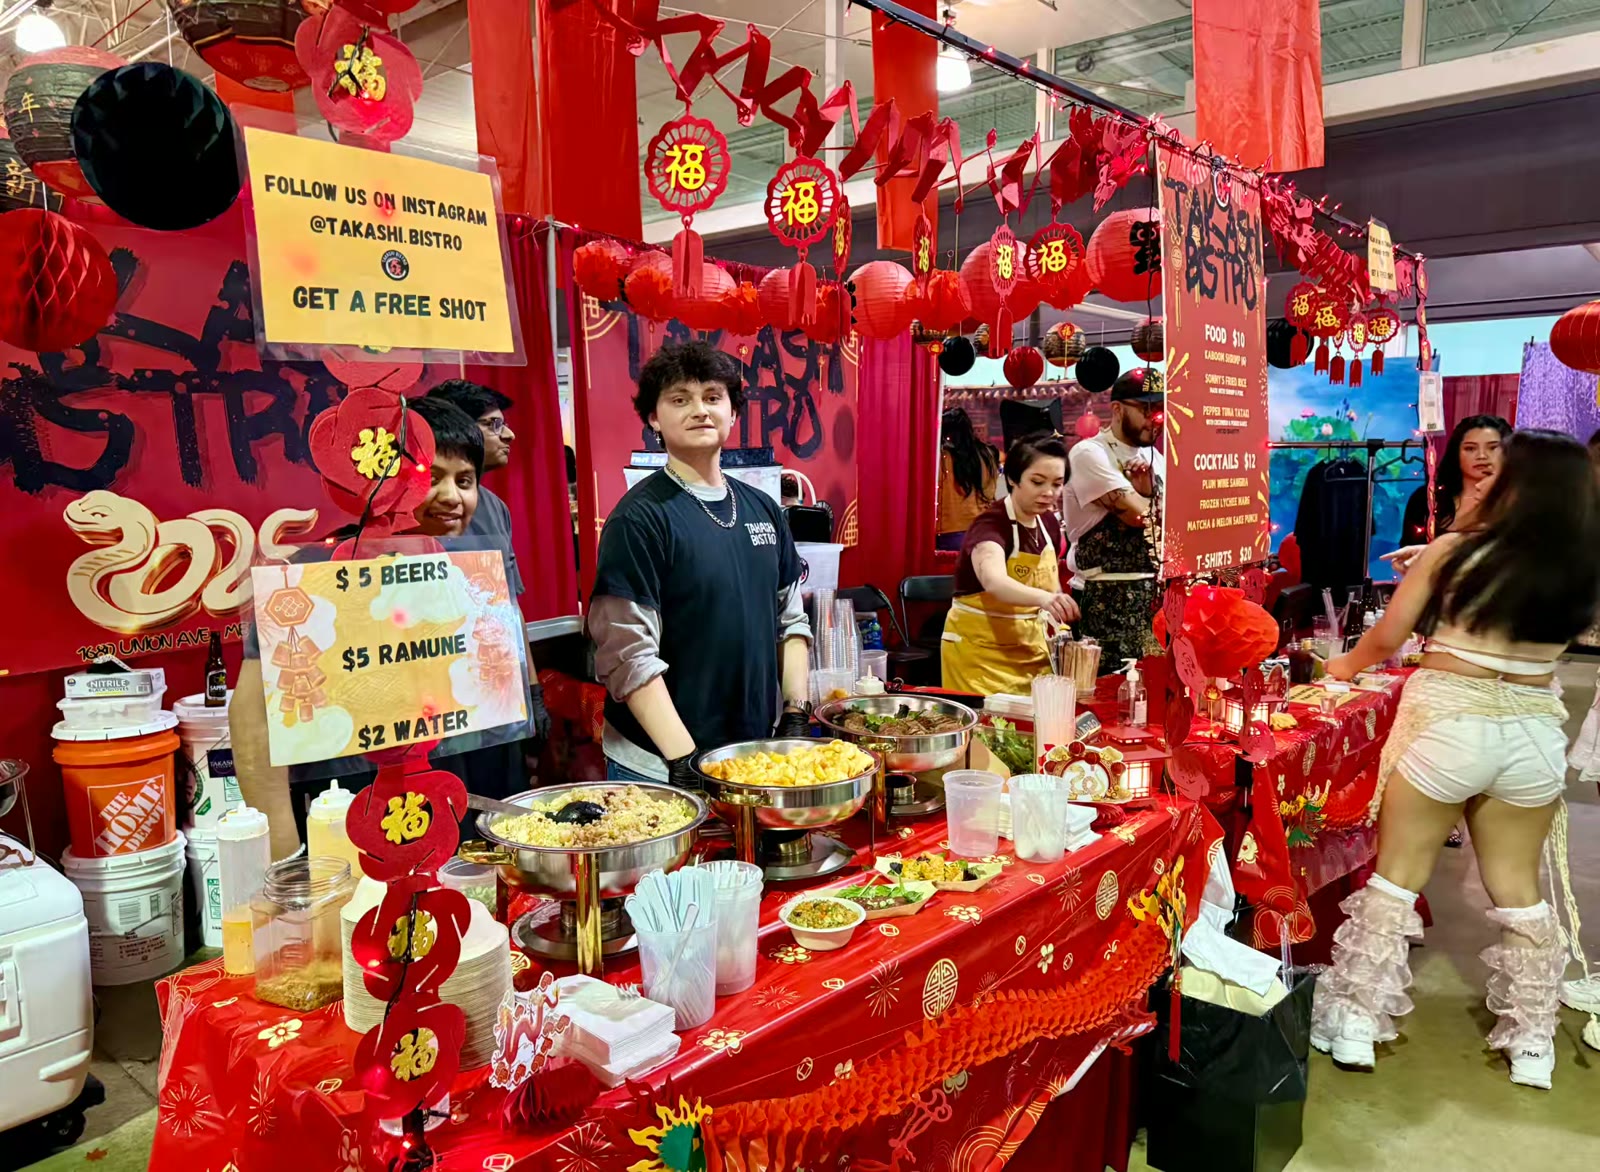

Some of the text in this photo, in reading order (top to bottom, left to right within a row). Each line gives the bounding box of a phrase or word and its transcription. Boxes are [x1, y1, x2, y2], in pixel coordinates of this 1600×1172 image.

[19, 92, 41, 123] 年
[665, 143, 706, 190] 福
[264, 174, 488, 226] FOLLOW US ON INSTAGRAM
[781, 180, 819, 226] 福
[310, 215, 463, 251] @TAKASHI.BISTRO
[996, 244, 1013, 279] 福
[1039, 239, 1068, 274] 福
[293, 285, 487, 321] GET A FREE SHOT
[1292, 294, 1310, 317] 福
[1314, 306, 1337, 329] 福
[1205, 323, 1245, 348] FOOD $10
[1371, 316, 1391, 336] 福
[1203, 405, 1221, 416] PEPPER
[1194, 451, 1256, 471] COCKTAILS $12
[1200, 498, 1220, 510] FROZEN
[1220, 496, 1238, 508] LYCHEE
[1187, 518, 1211, 531] MATCHA
[381, 560, 449, 586] BEERS
[1196, 546, 1252, 570] T-SHIRTS $20
[119, 633, 174, 656] UNION
[342, 634, 467, 672] $5 RAMUNE
[90, 679, 127, 689] NITRILE
[358, 710, 469, 750] $2 WATER
[95, 778, 165, 855] HOME
[99, 791, 132, 821] THE
[381, 791, 430, 845] 福
[124, 801, 165, 851] DEPOT
[391, 1026, 437, 1083] 福
[1522, 1049, 1540, 1058] FILA
